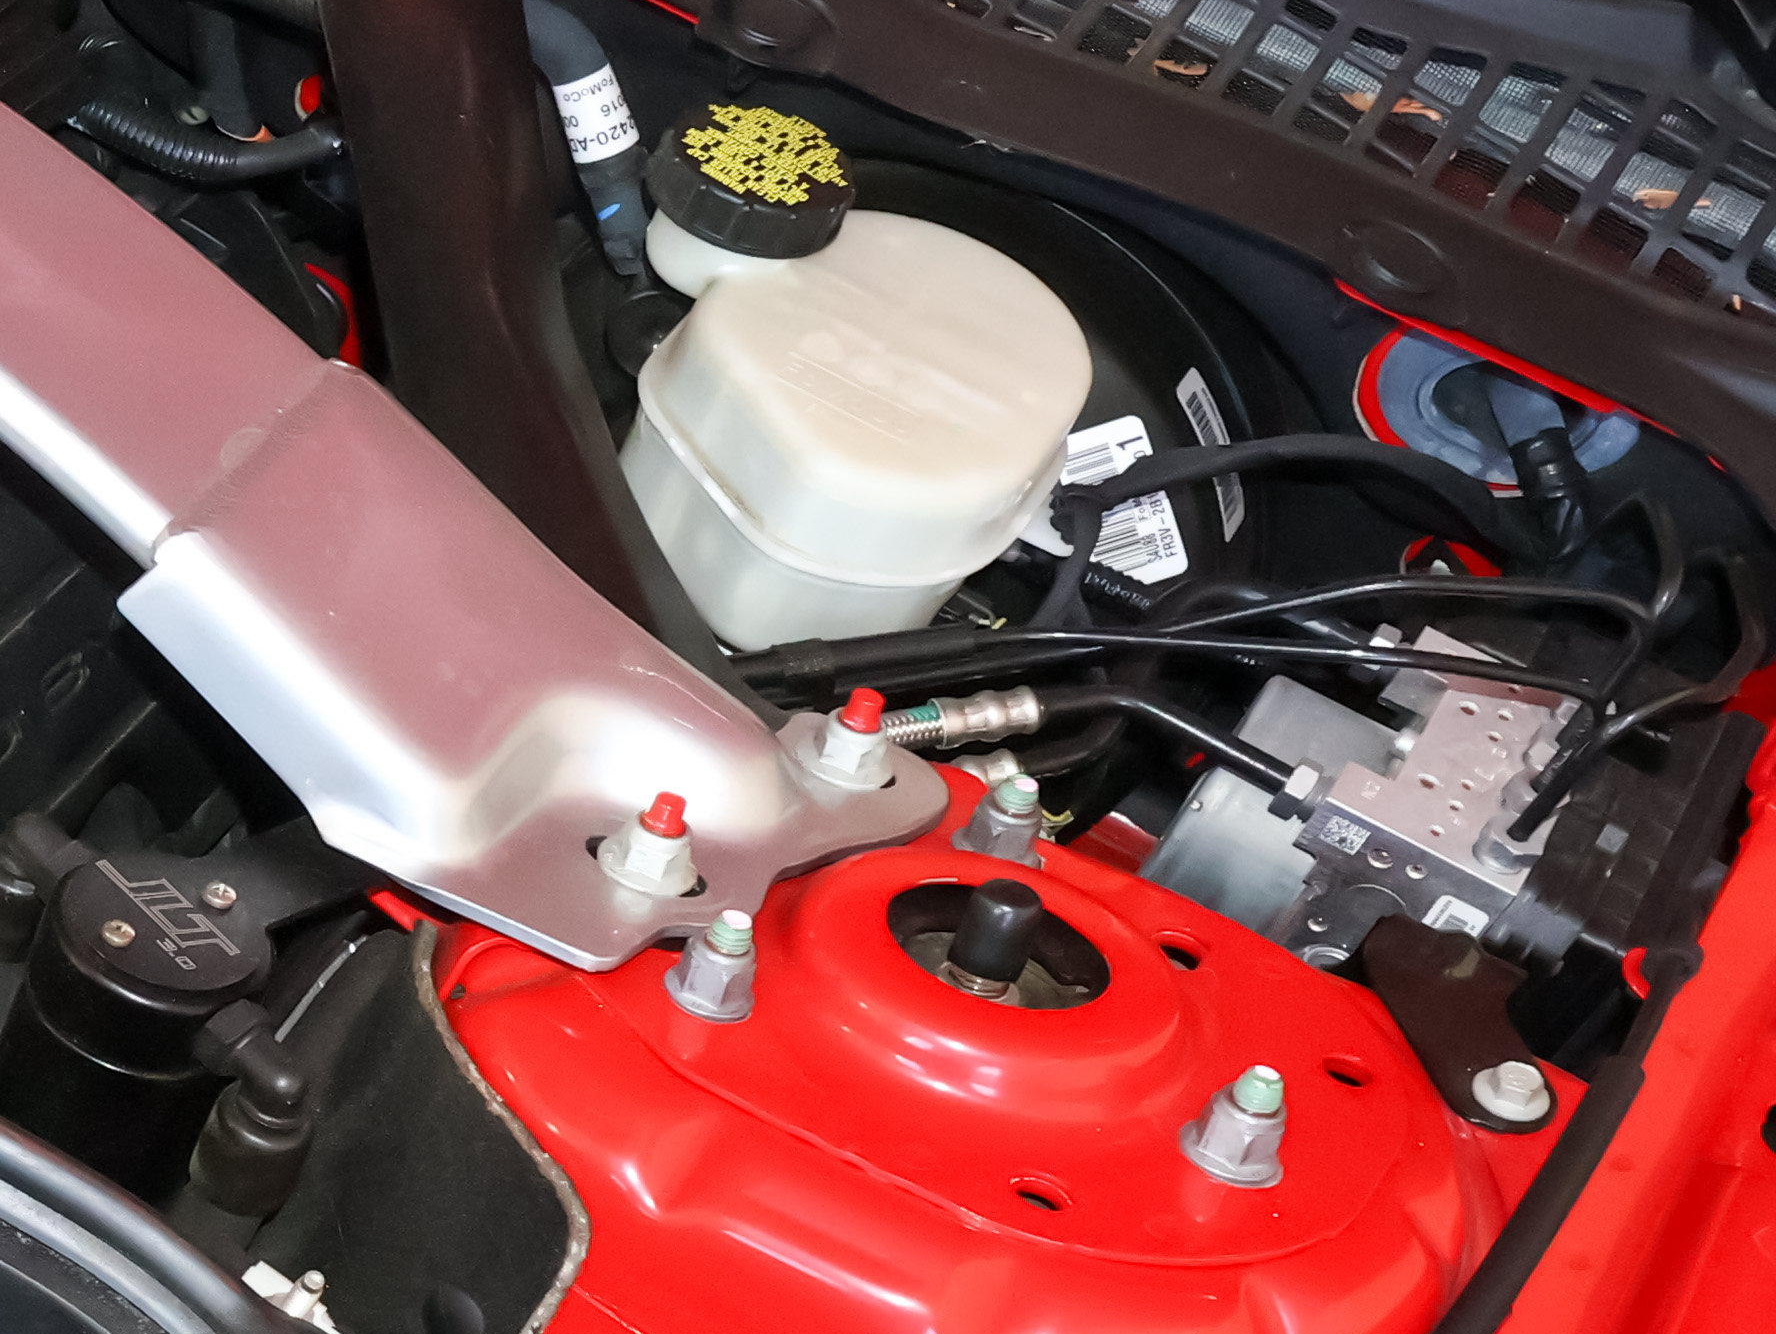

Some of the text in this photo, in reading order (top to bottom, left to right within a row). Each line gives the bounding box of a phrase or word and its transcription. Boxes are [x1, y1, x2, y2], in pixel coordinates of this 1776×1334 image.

[563, 73, 614, 102] FoMoCo
[683, 145, 779, 204] CLEAN FILLER CAP
[757, 166, 784, 182] DOT
[756, 176, 799, 206] BEFORE
[779, 181, 811, 202] ONLY
[94, 859, 242, 958] JLT
[155, 937, 197, 972] 3.0
